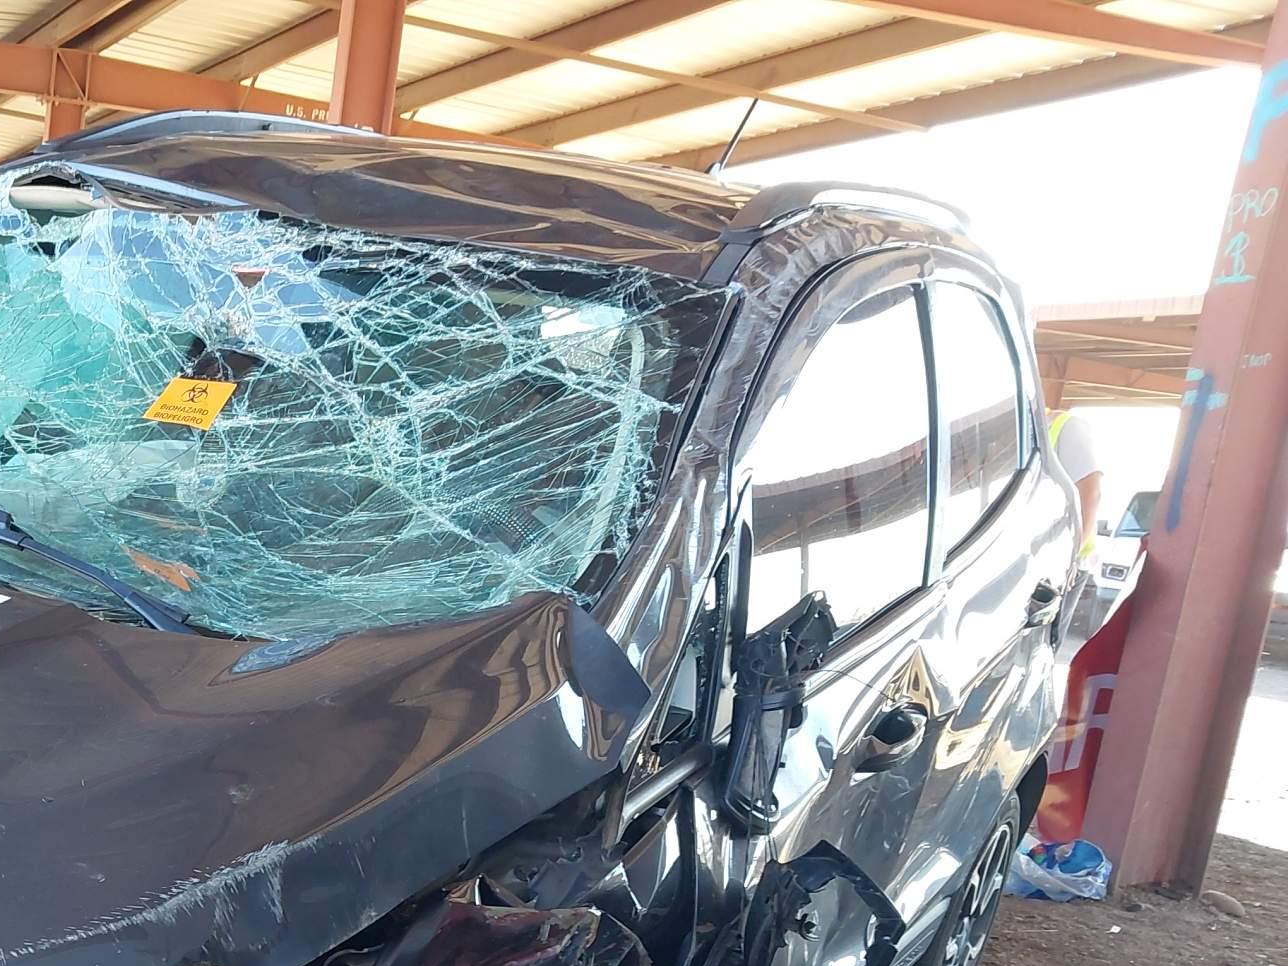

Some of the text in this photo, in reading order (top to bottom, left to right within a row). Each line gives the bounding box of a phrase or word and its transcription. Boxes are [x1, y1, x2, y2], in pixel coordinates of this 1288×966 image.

[285, 103, 306, 118] U.S.
[160, 403, 209, 416] BIOHAZARD
[153, 411, 203, 425] BIOPELIGRO
